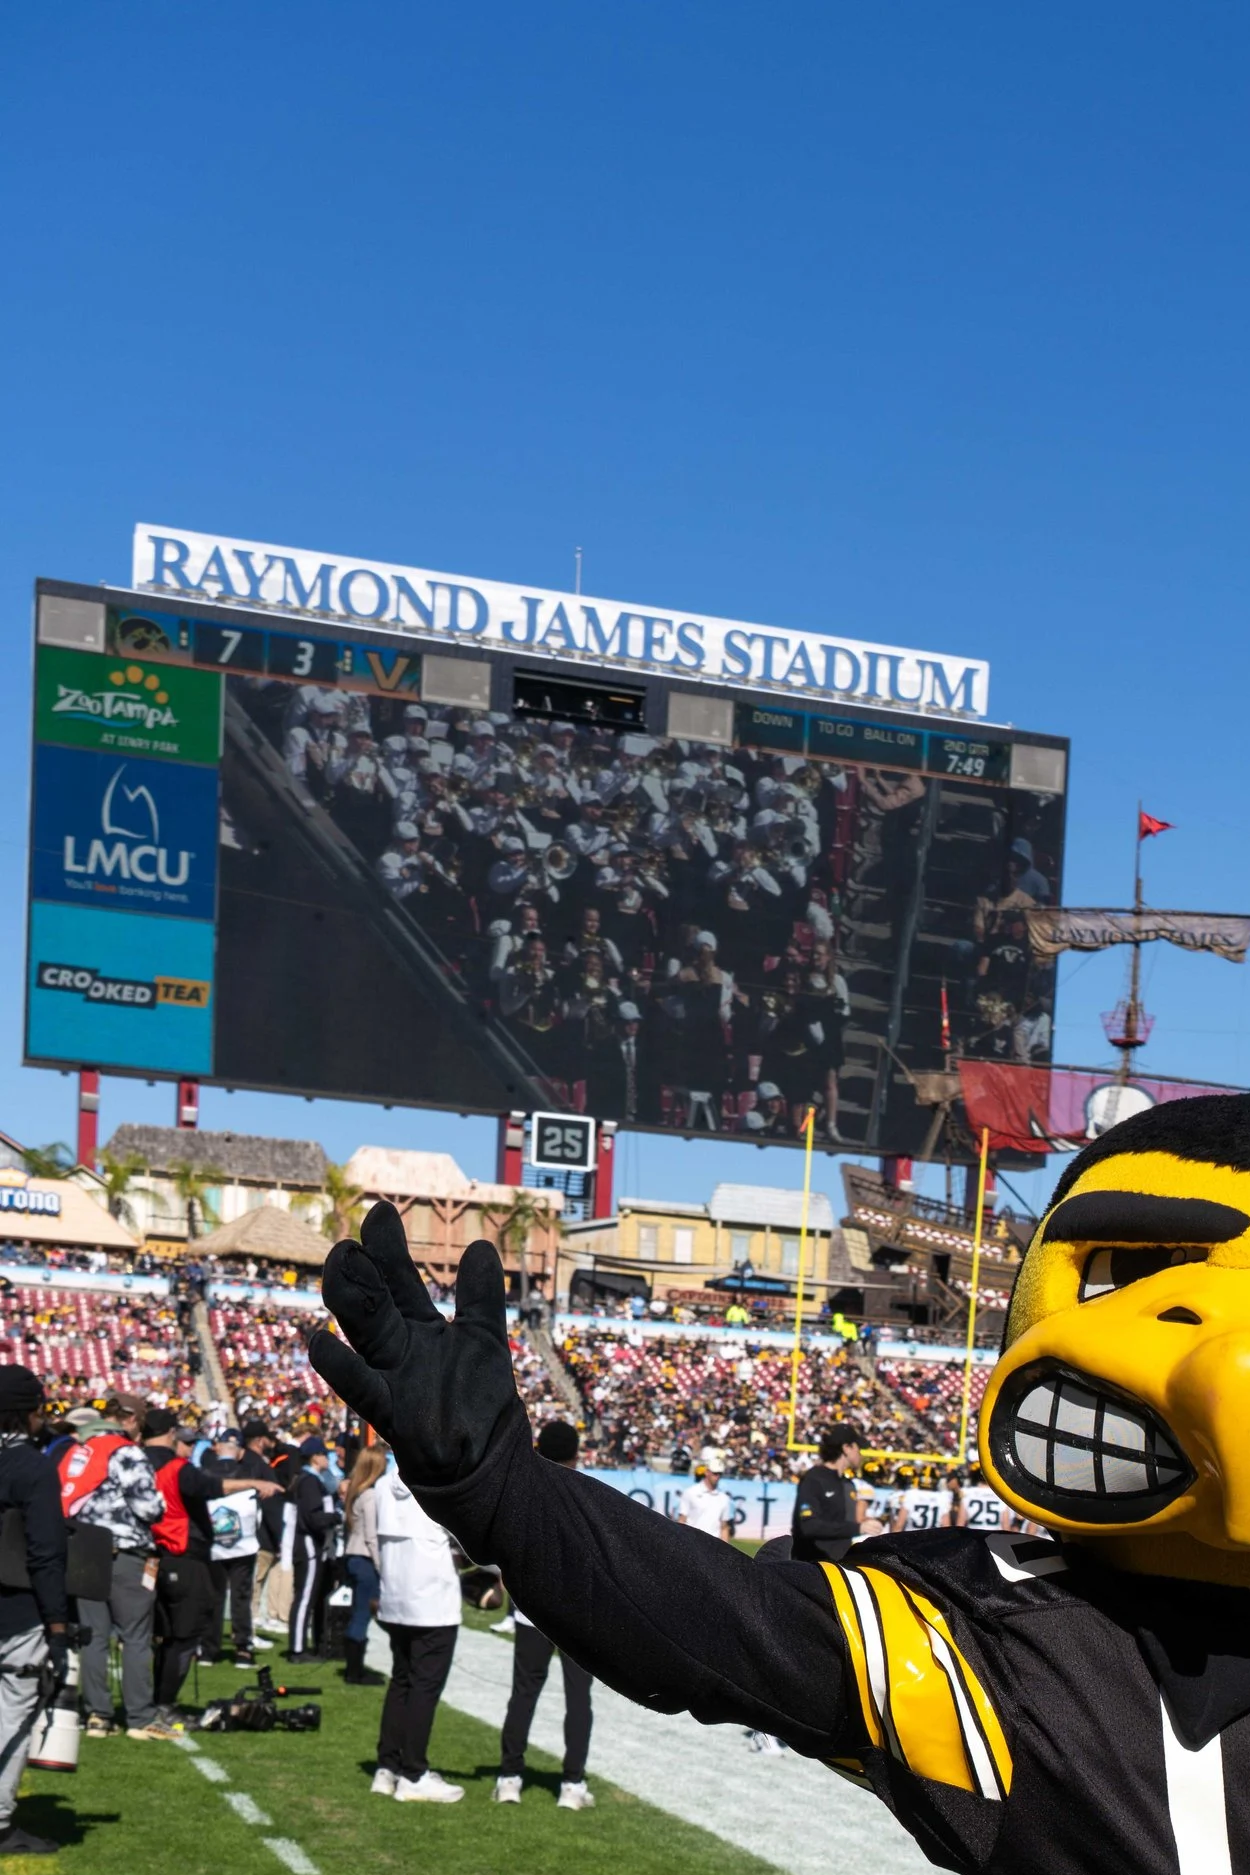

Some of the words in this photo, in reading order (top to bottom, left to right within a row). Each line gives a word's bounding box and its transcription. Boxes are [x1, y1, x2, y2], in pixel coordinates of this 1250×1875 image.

[148, 535, 490, 636] RAYMOND
[501, 596, 706, 668] JAMES
[722, 629, 980, 713] STADIUM
[218, 630, 242, 664] 7
[293, 641, 315, 676] 3
[752, 711, 793, 728] DOWN
[818, 720, 835, 734] TO
[836, 722, 854, 737] GO
[863, 727, 894, 744] BALL
[897, 731, 916, 746] ON
[944, 739, 966, 753] 2ND
[946, 754, 985, 777] 7:49
[64, 835, 190, 886] LMCU
[42, 967, 152, 1004] CROOKED
[161, 982, 203, 1002] TEA
[543, 1126, 583, 1159] 25
[913, 1505, 939, 1528] 31
[969, 1500, 1000, 1525] 25
